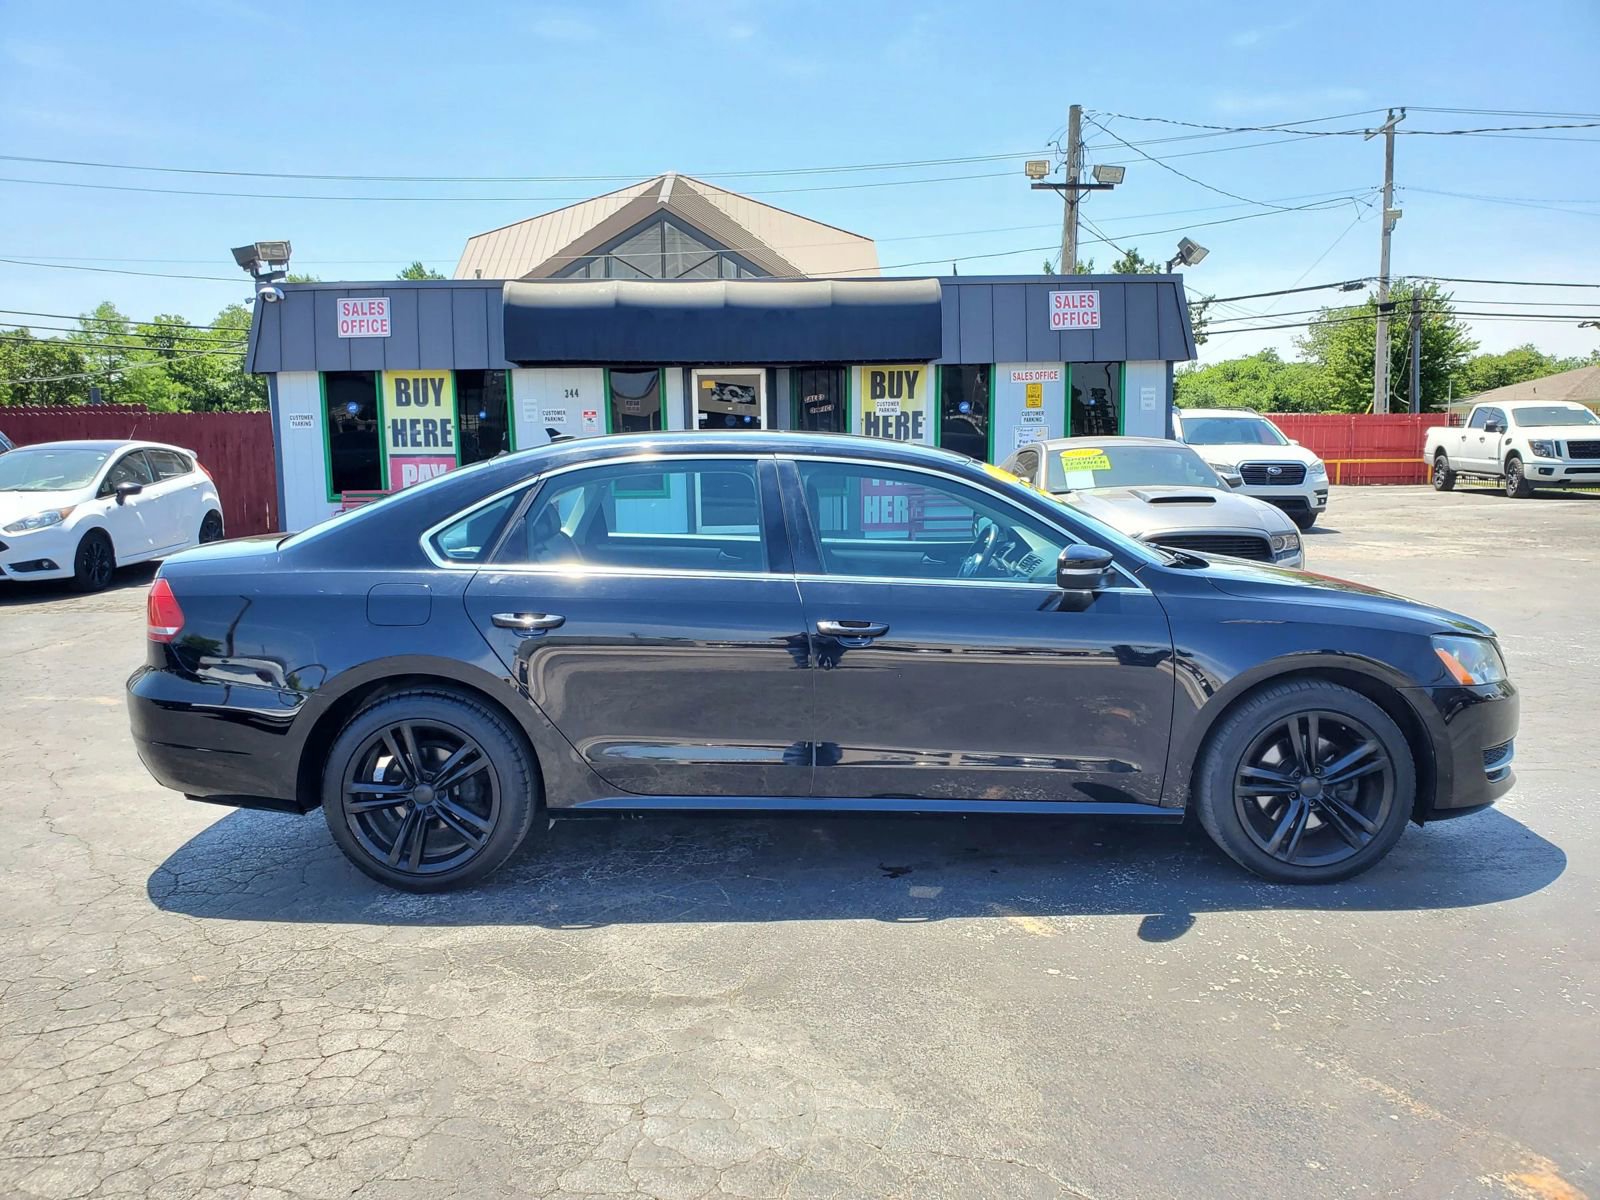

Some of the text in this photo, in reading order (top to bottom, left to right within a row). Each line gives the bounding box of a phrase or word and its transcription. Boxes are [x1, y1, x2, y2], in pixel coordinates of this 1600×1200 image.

[343, 301, 385, 317] SALES
[1055, 294, 1094, 309] SALES
[341, 318, 388, 334] OFFICE
[1053, 311, 1097, 326] OFFICE
[1012, 370, 1059, 381] SALES OFFICE
[394, 377, 445, 408] BUY
[870, 370, 919, 400] BUY
[564, 388, 579, 399] 344
[391, 418, 453, 448] HERE
[864, 410, 924, 441] HERE
[863, 495, 909, 524] HER
